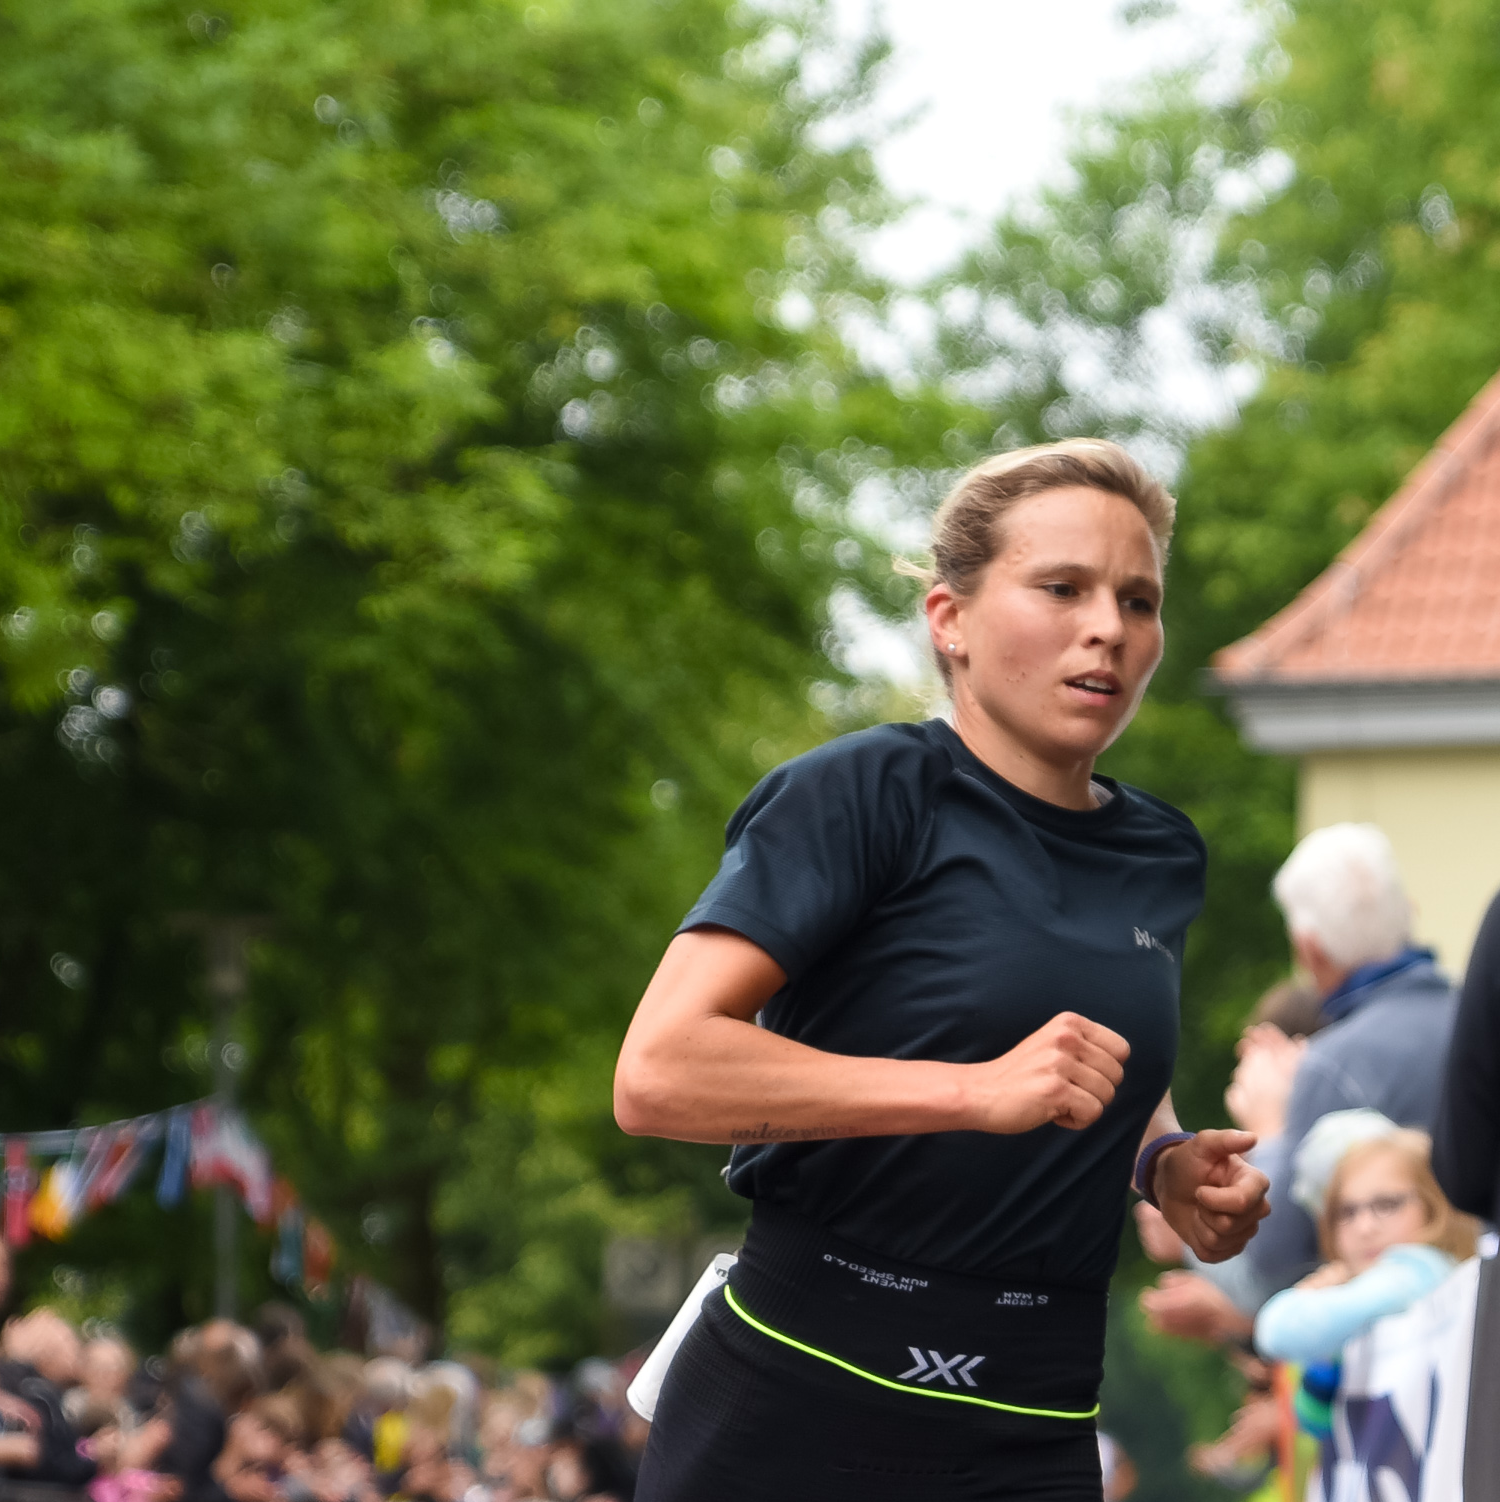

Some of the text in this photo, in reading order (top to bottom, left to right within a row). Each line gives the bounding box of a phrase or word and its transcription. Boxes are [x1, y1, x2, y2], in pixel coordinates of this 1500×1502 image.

[823, 1254, 928, 1288] RUN SPEED 4.0
[860, 1274, 913, 1292] INVENT
[1003, 1291, 1032, 1300] MAN
